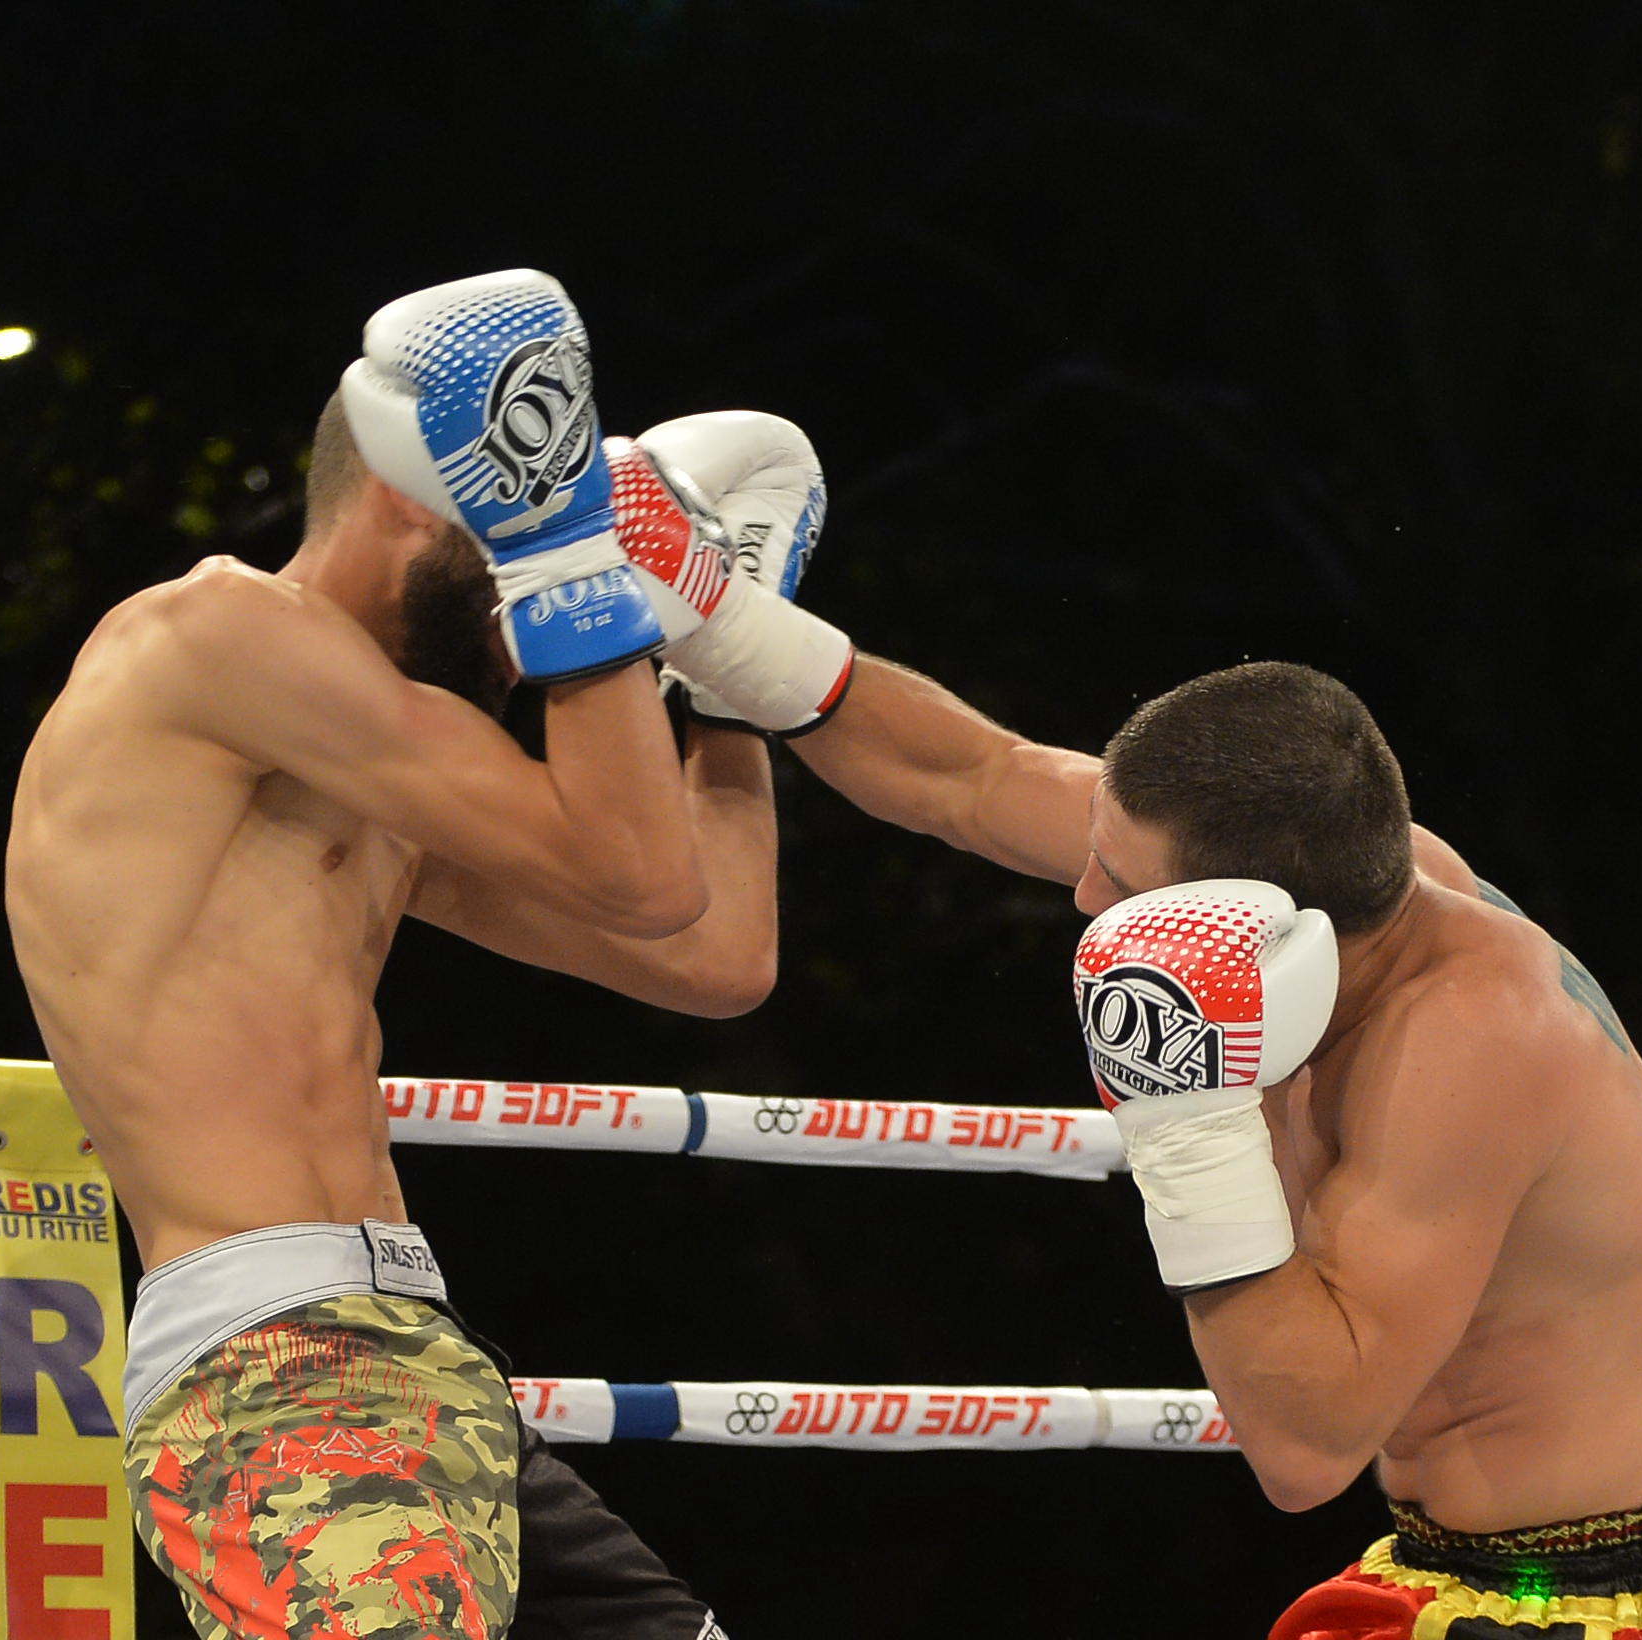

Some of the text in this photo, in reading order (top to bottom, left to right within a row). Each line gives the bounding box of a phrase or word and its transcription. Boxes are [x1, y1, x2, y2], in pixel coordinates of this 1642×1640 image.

[1079, 974, 1225, 1091] JOYA
[384, 1081, 638, 1129] UTO SOFT
[803, 1098, 1077, 1152] AUTO SOFT
[773, 1392, 1053, 1437] AUTO SOFT
